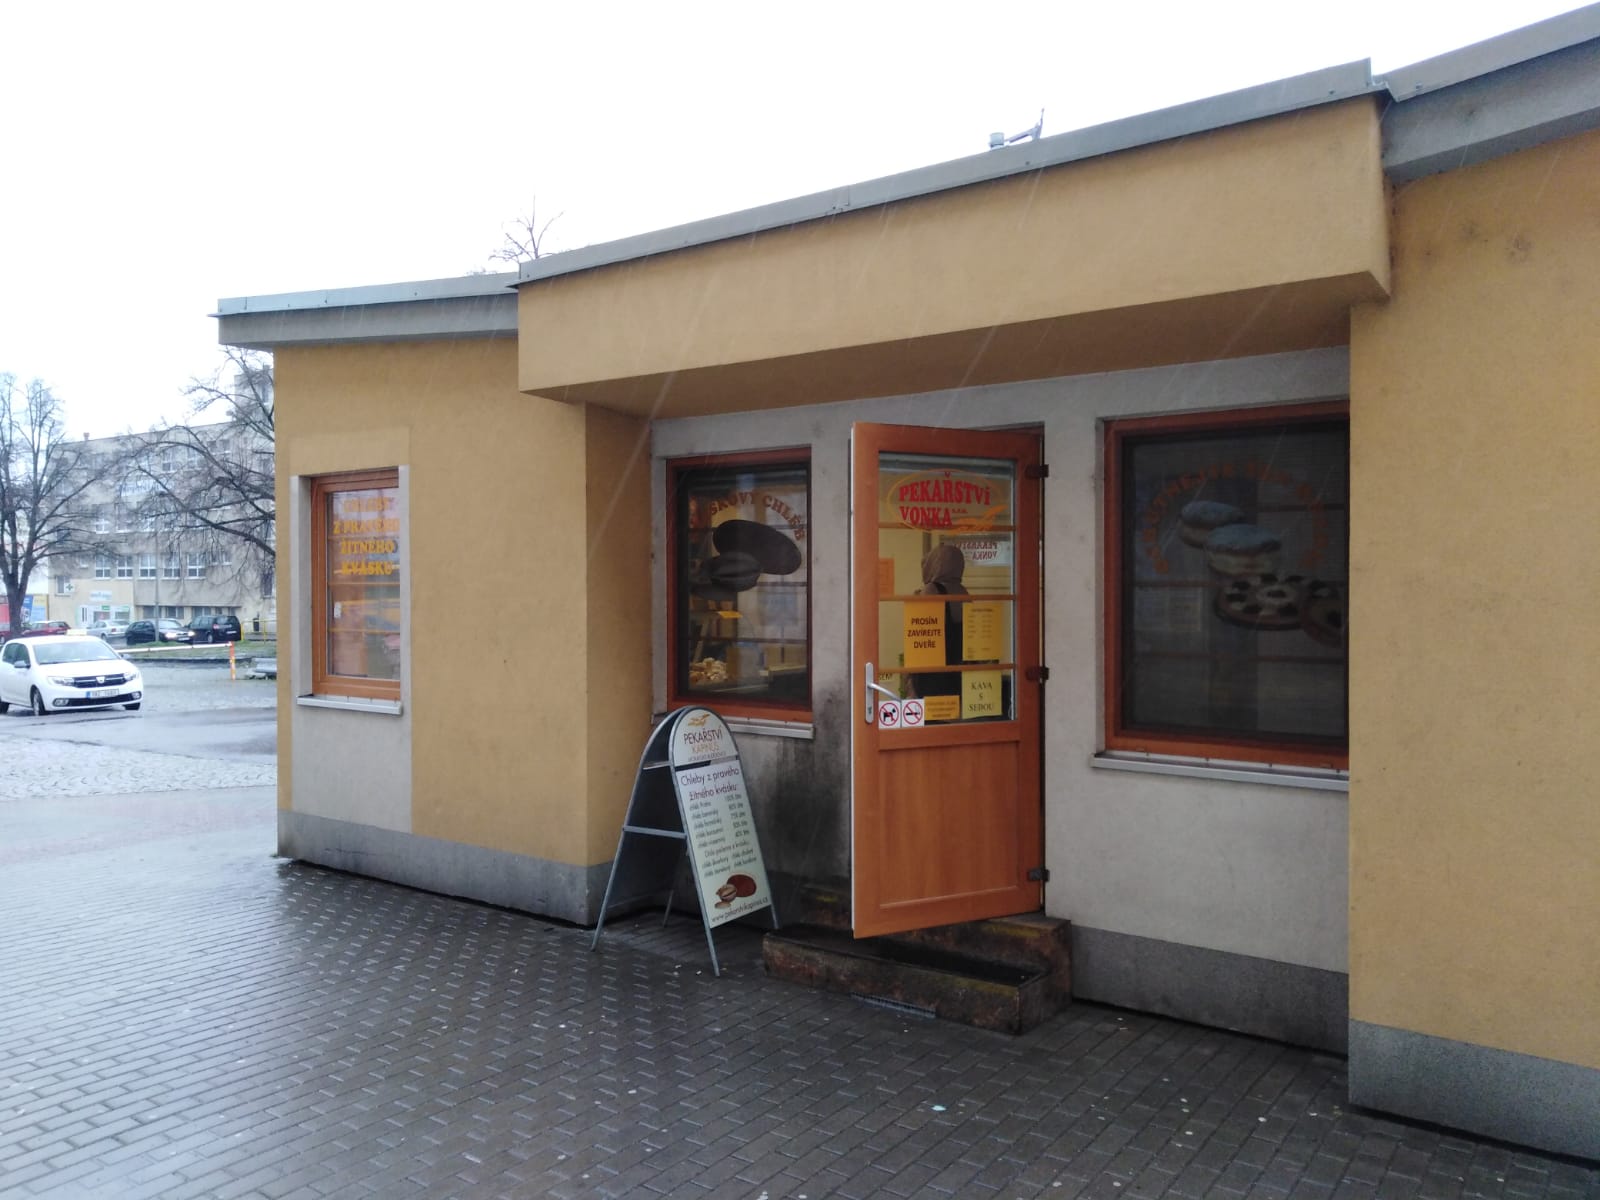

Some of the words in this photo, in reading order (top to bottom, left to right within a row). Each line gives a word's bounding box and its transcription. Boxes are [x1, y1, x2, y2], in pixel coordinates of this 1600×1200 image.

[898, 471, 991, 506] PEKAŘSTVÍ
[899, 506, 953, 528] VONKA
[911, 616, 938, 625] PROSÍM
[907, 628, 941, 637] ZAVÍREJTE
[913, 639, 937, 649] DVEŘE
[683, 725, 722, 744] PEKAŘSTVÍ
[680, 770, 705, 786] Chleby
